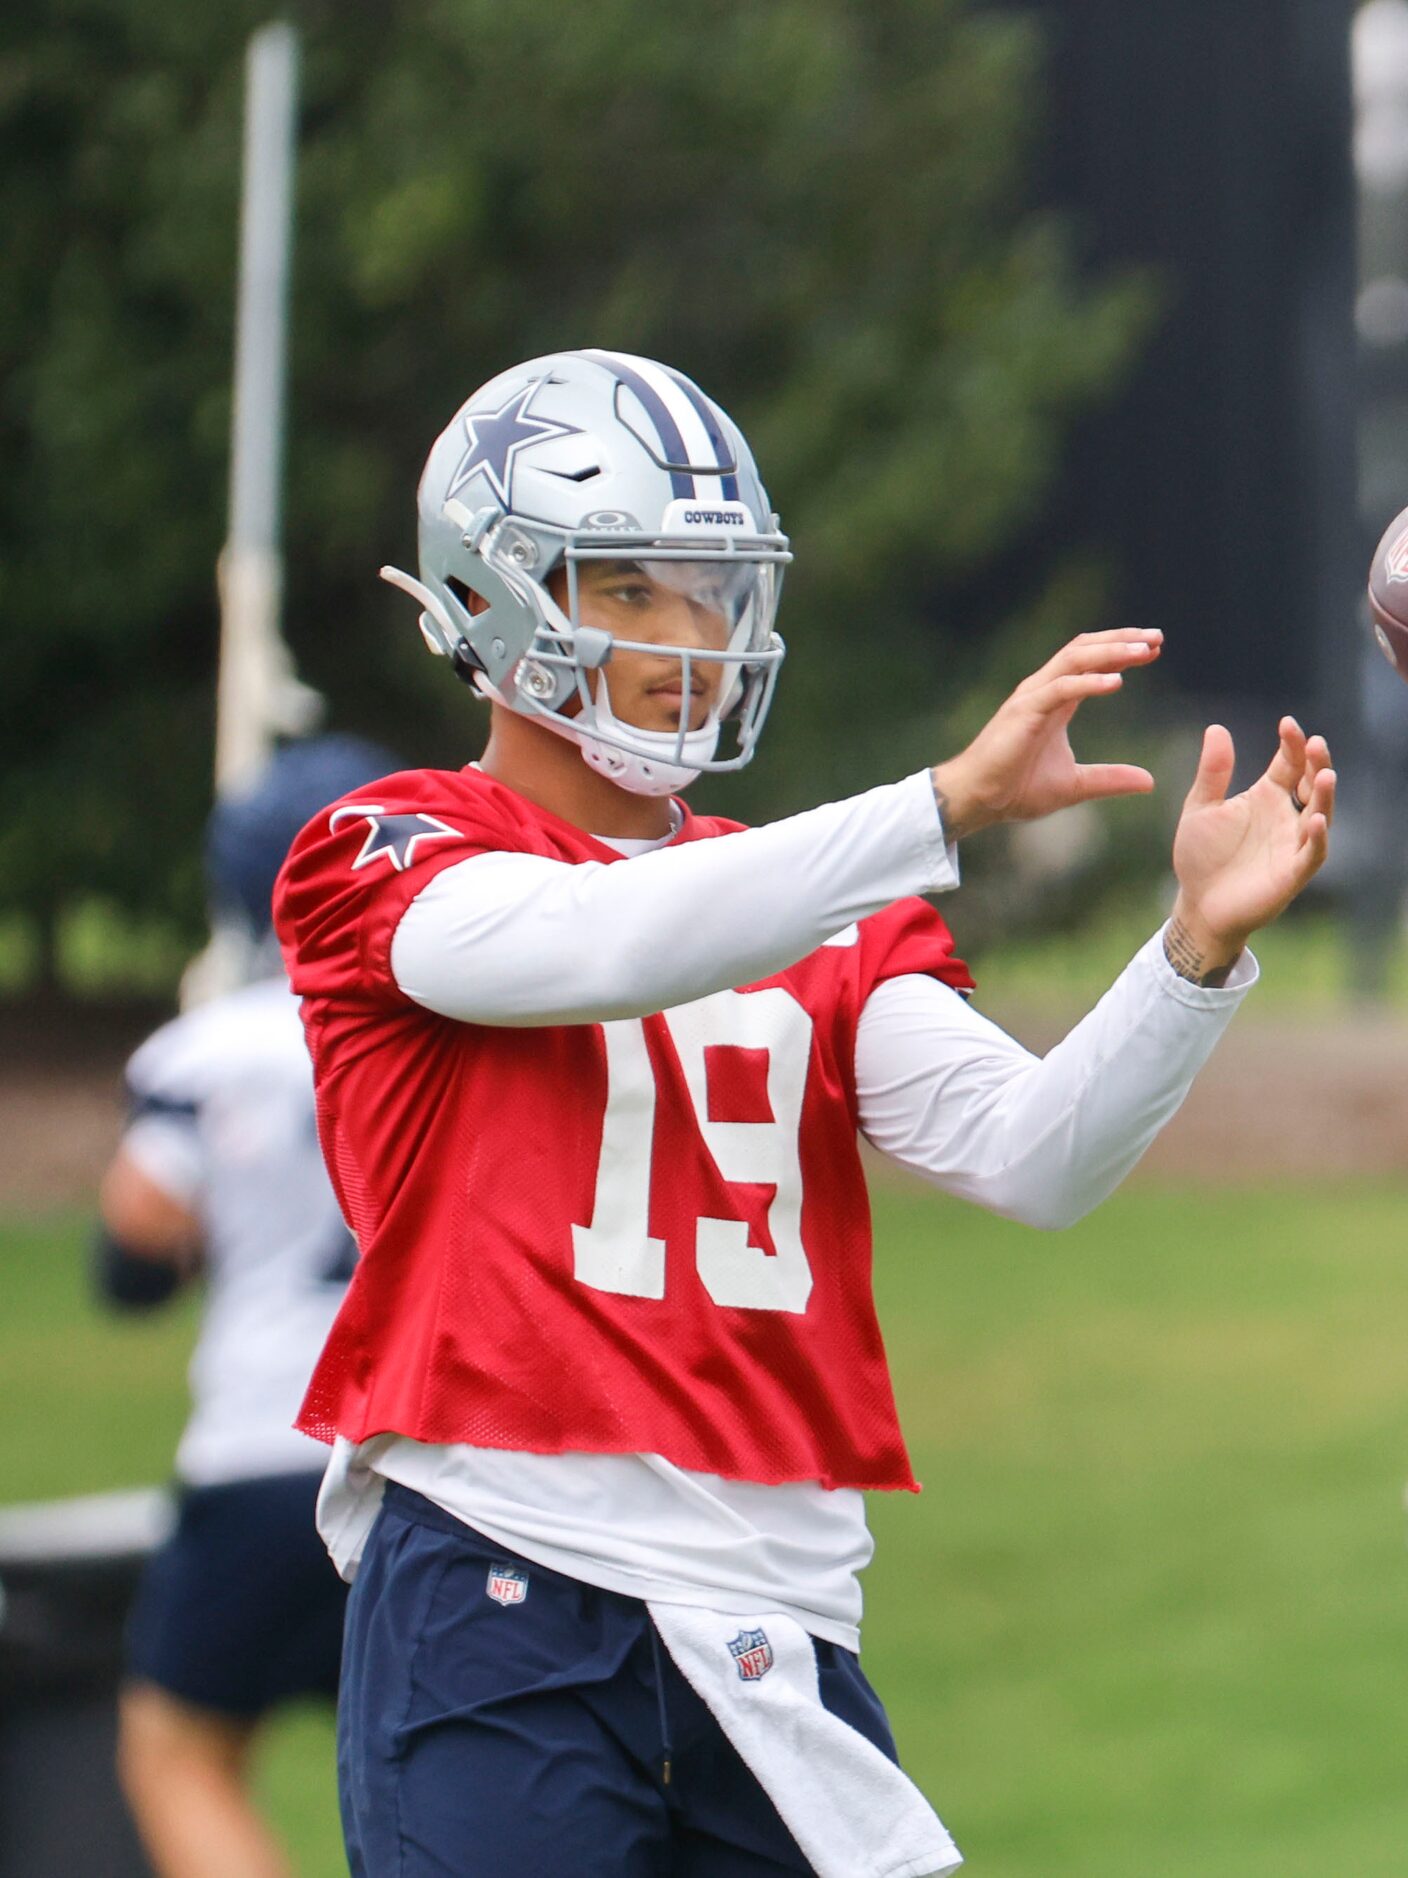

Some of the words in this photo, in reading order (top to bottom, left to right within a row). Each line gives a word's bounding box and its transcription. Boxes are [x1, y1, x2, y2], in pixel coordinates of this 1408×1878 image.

[684, 510, 744, 525] COWBOYS
[571, 987, 813, 1314] 19
[492, 1578, 521, 1600] NFL
[738, 1647, 769, 1677] NFL
